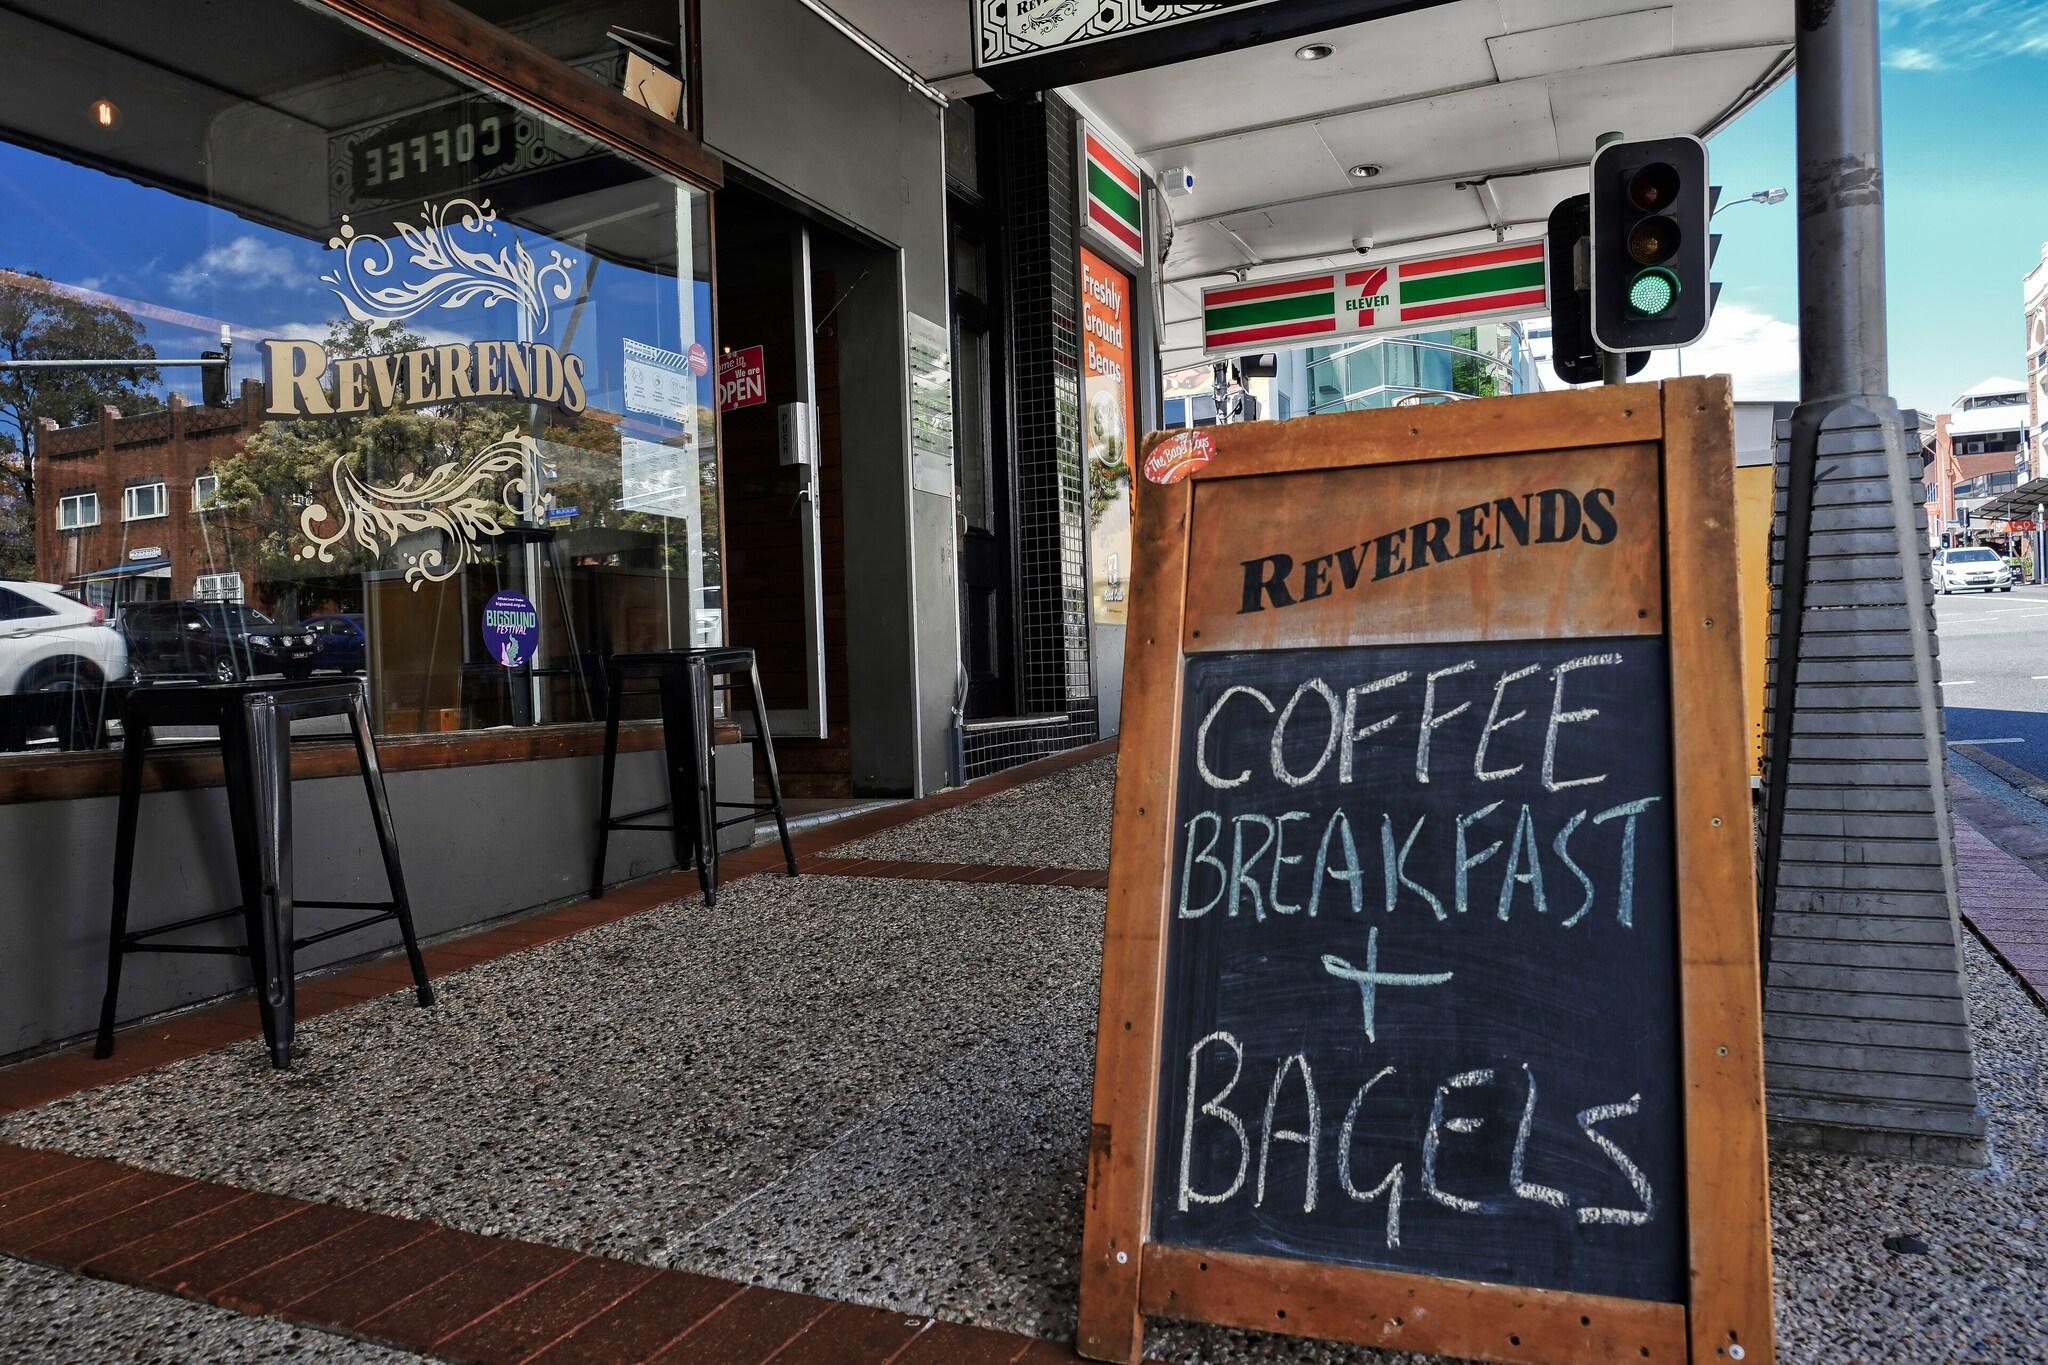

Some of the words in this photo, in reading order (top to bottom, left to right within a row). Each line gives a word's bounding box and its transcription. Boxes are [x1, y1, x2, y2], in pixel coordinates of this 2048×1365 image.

[1083, 263, 1121, 320] Freshly
[1083, 302, 1123, 351] Ground
[257, 338, 587, 416] REVERENDS
[734, 369, 746, 379] We
[747, 367, 760, 375] are
[736, 356, 747, 368] in
[1088, 340, 1121, 384] Beans
[1148, 455, 1166, 472] The
[1163, 440, 1187, 463] Bagel
[1237, 487, 1618, 615] REVERENDS
[486, 609, 536, 628] BIGSOUND
[496, 624, 527, 635] FESTIVAL
[1196, 652, 1623, 792] COFFEE
[1178, 796, 1662, 928] BREAKFAST
[1178, 1031, 1656, 1249] BAGELS
